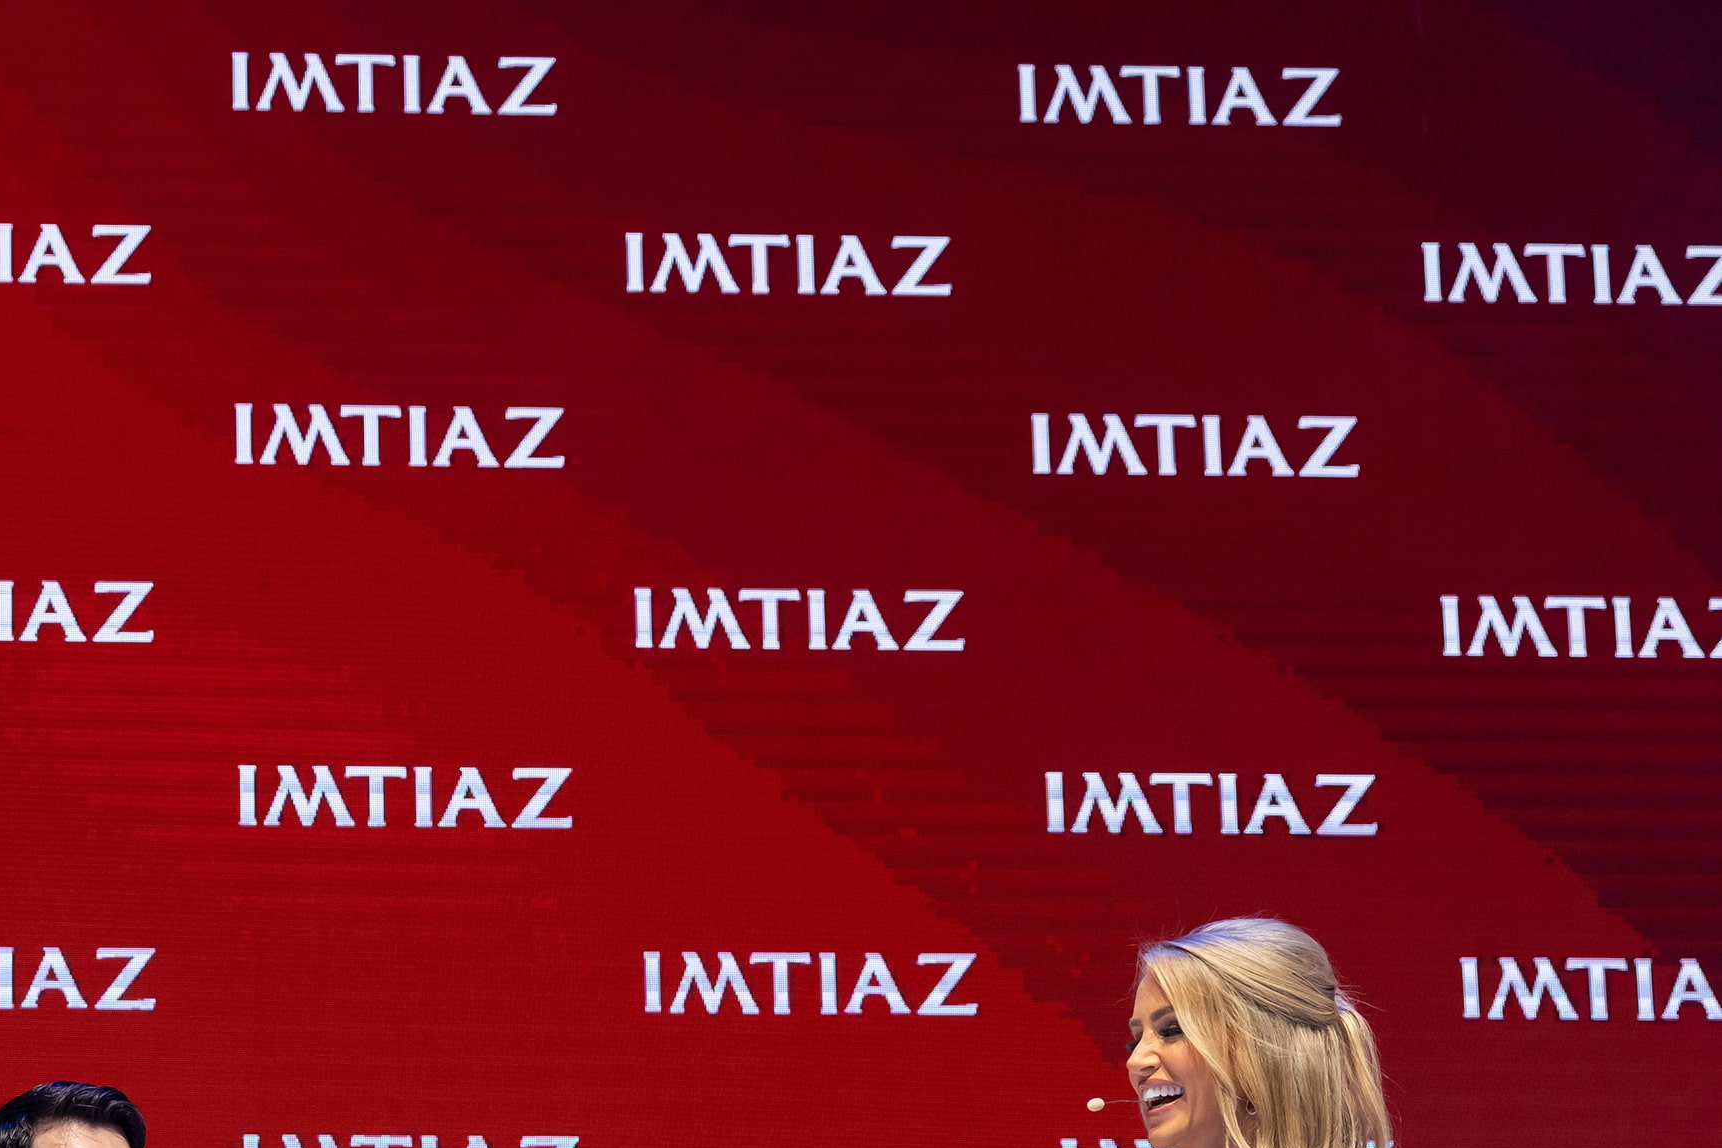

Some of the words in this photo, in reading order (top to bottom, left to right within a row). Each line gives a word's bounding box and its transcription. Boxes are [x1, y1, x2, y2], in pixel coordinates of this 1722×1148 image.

[232, 52, 557, 115] IMTIAZ
[1018, 64, 1341, 126] IMTIAZ
[625, 233, 952, 295] IMTIAZ
[236, 403, 565, 468] IMTIAZ
[1031, 413, 1360, 477] IMTIAZ
[634, 588, 965, 651] IMTIAZ
[1440, 596, 1722, 658] IMTIA
[238, 765, 572, 828] IMTIAZ
[1045, 772, 1377, 835] IMTIAZ
[644, 952, 978, 1015] IMTIAZ
